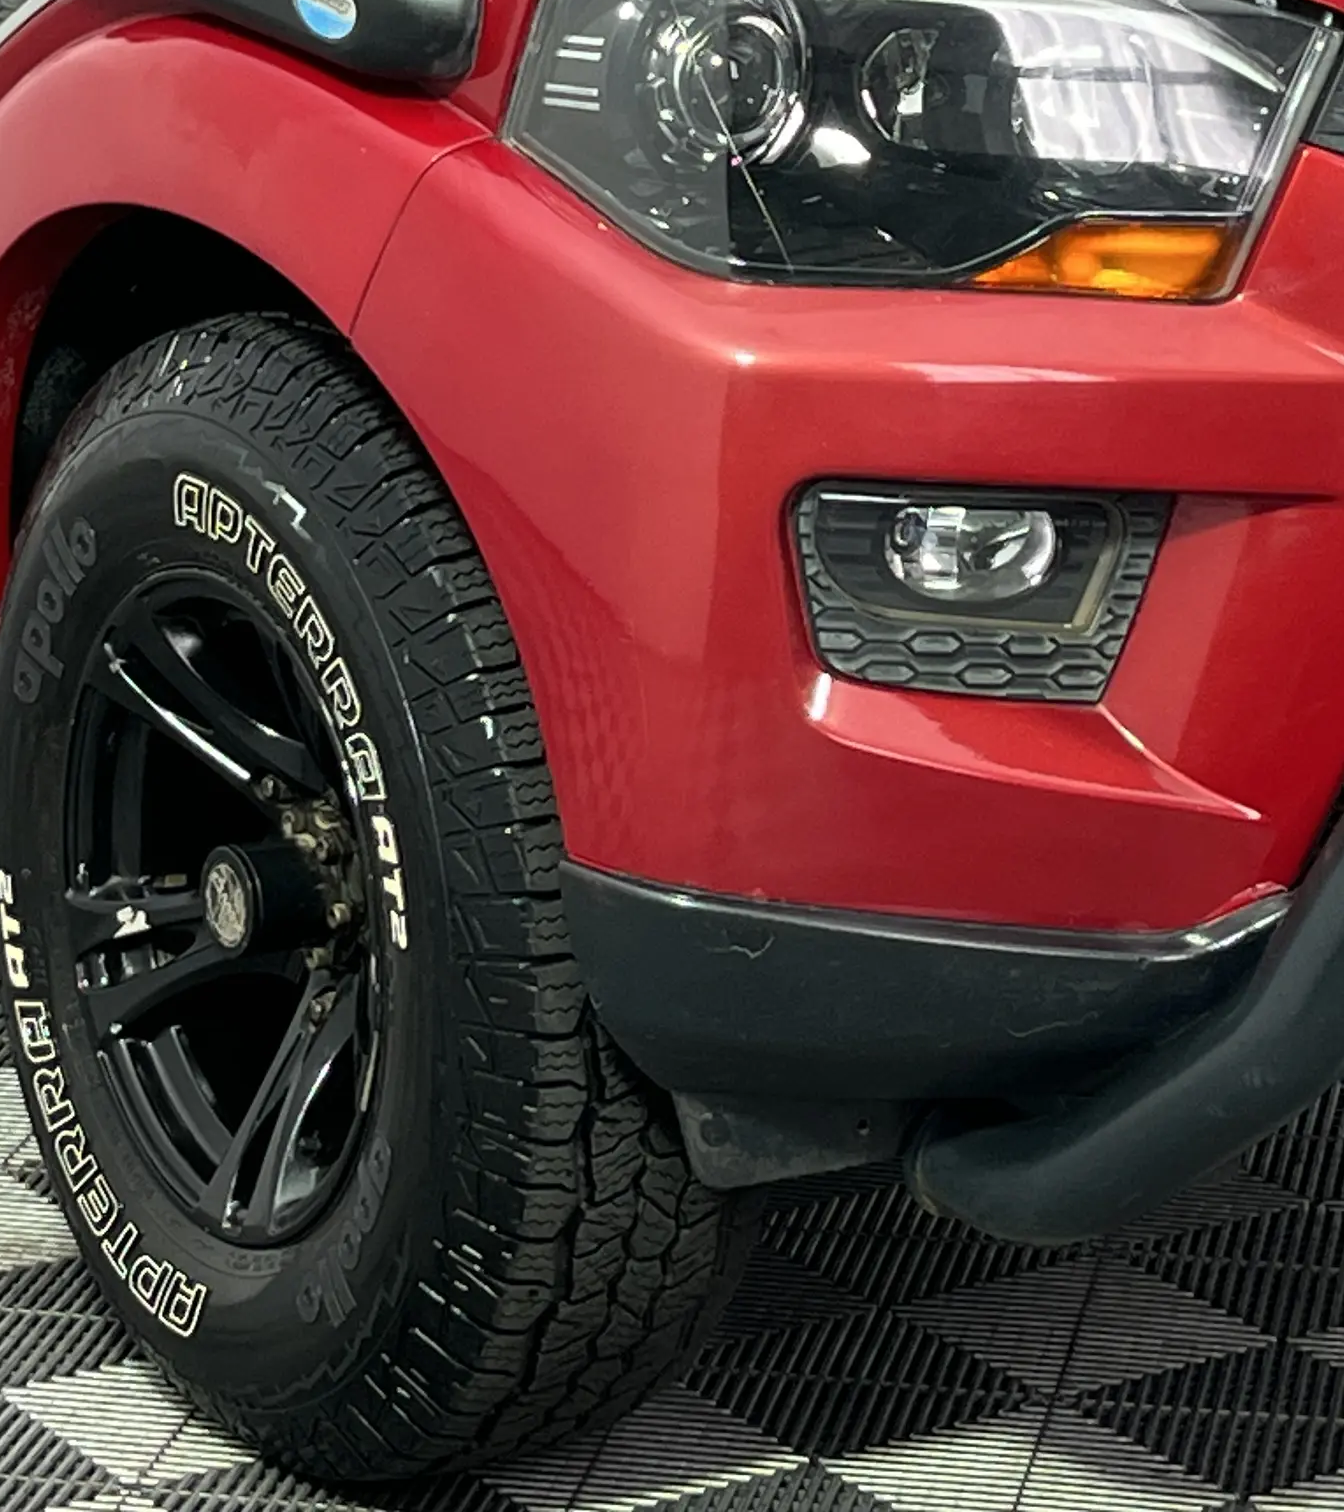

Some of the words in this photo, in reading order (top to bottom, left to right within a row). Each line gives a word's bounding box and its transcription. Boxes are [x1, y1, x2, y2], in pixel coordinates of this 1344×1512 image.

[13, 516, 97, 704] apollo
[173, 471, 387, 801] APTERRA
[13, 999, 208, 1338] APTERRA
[296, 1135, 392, 1329] apollo
